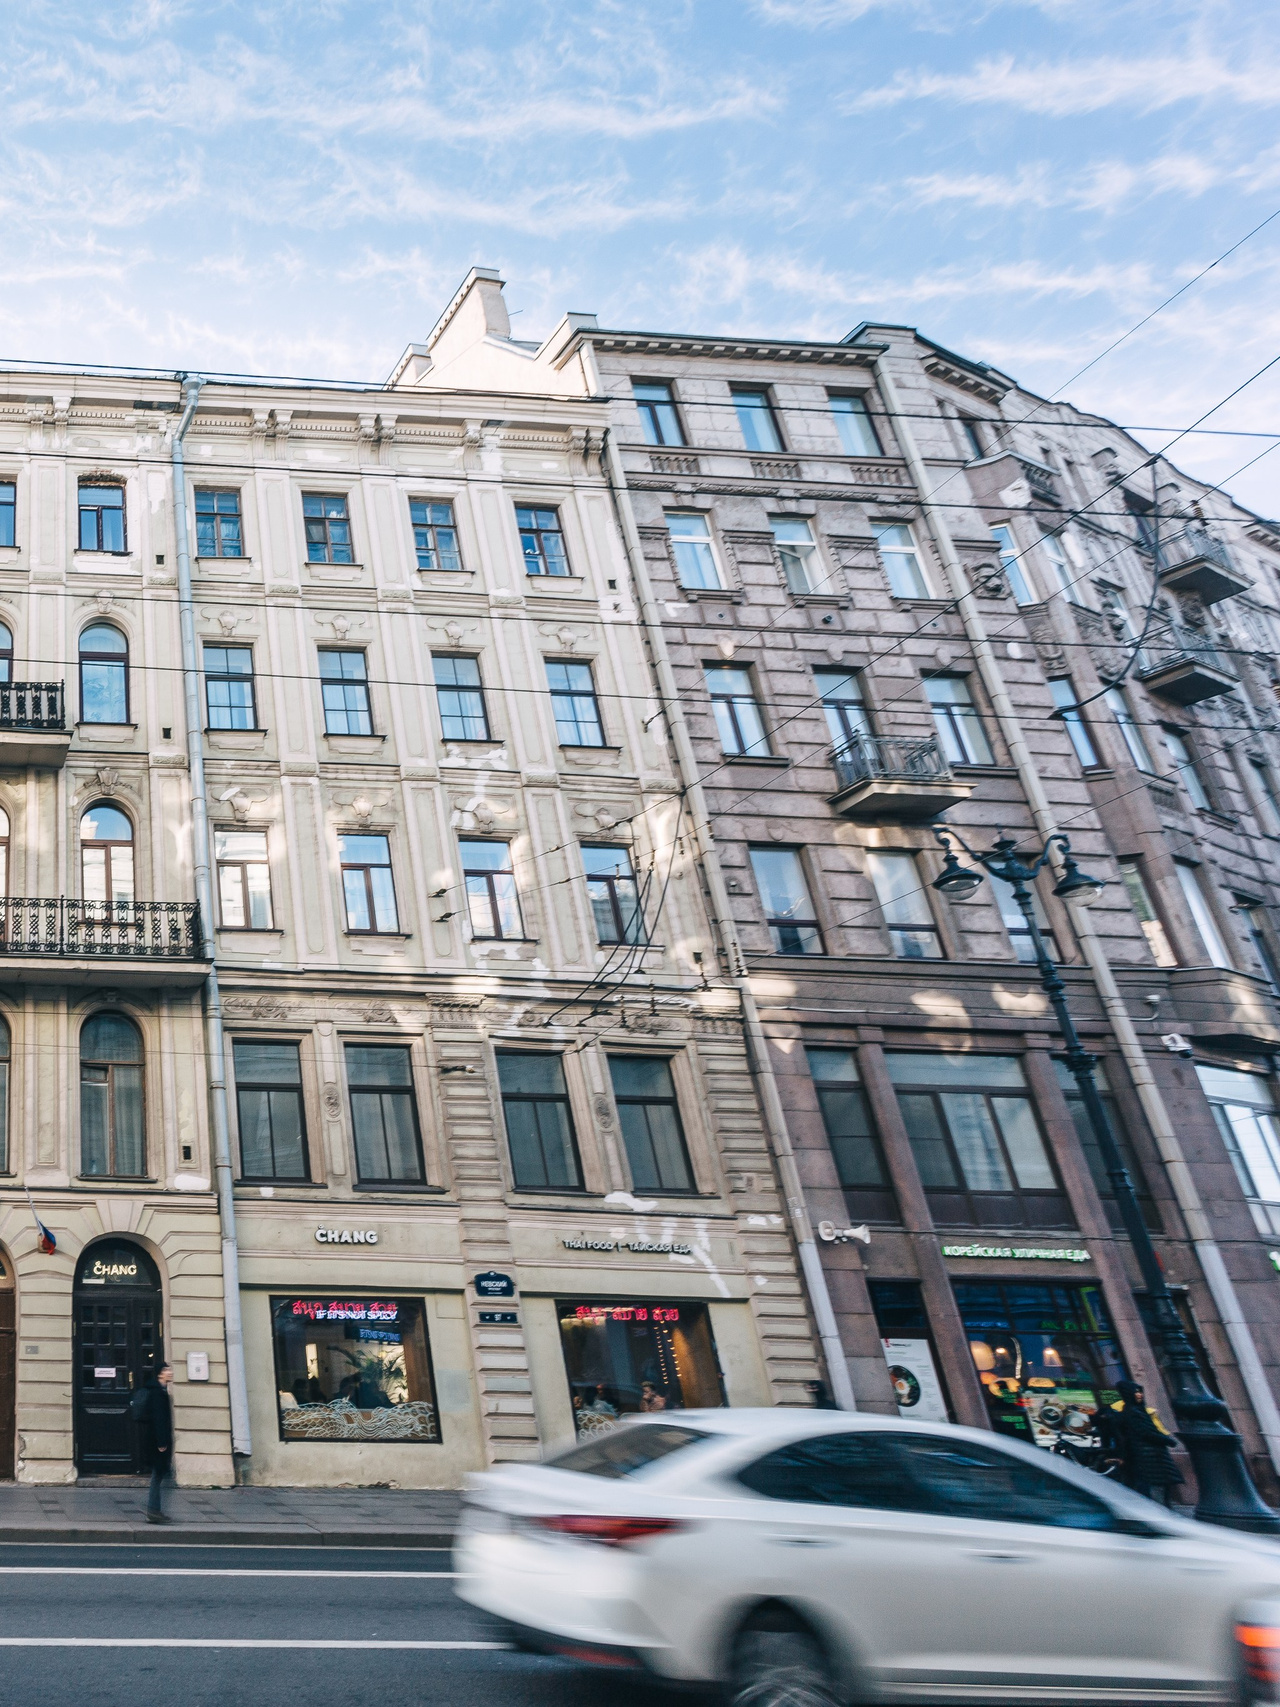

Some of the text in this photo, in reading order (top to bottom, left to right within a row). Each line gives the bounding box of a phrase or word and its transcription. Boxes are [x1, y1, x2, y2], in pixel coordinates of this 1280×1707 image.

[563, 1240, 586, 1249] THAI
[587, 1241, 614, 1250] FOOD
[943, 1244, 1013, 1258] КОРЕЙСКАЯ
[1067, 1249, 1091, 1262] ЕДА
